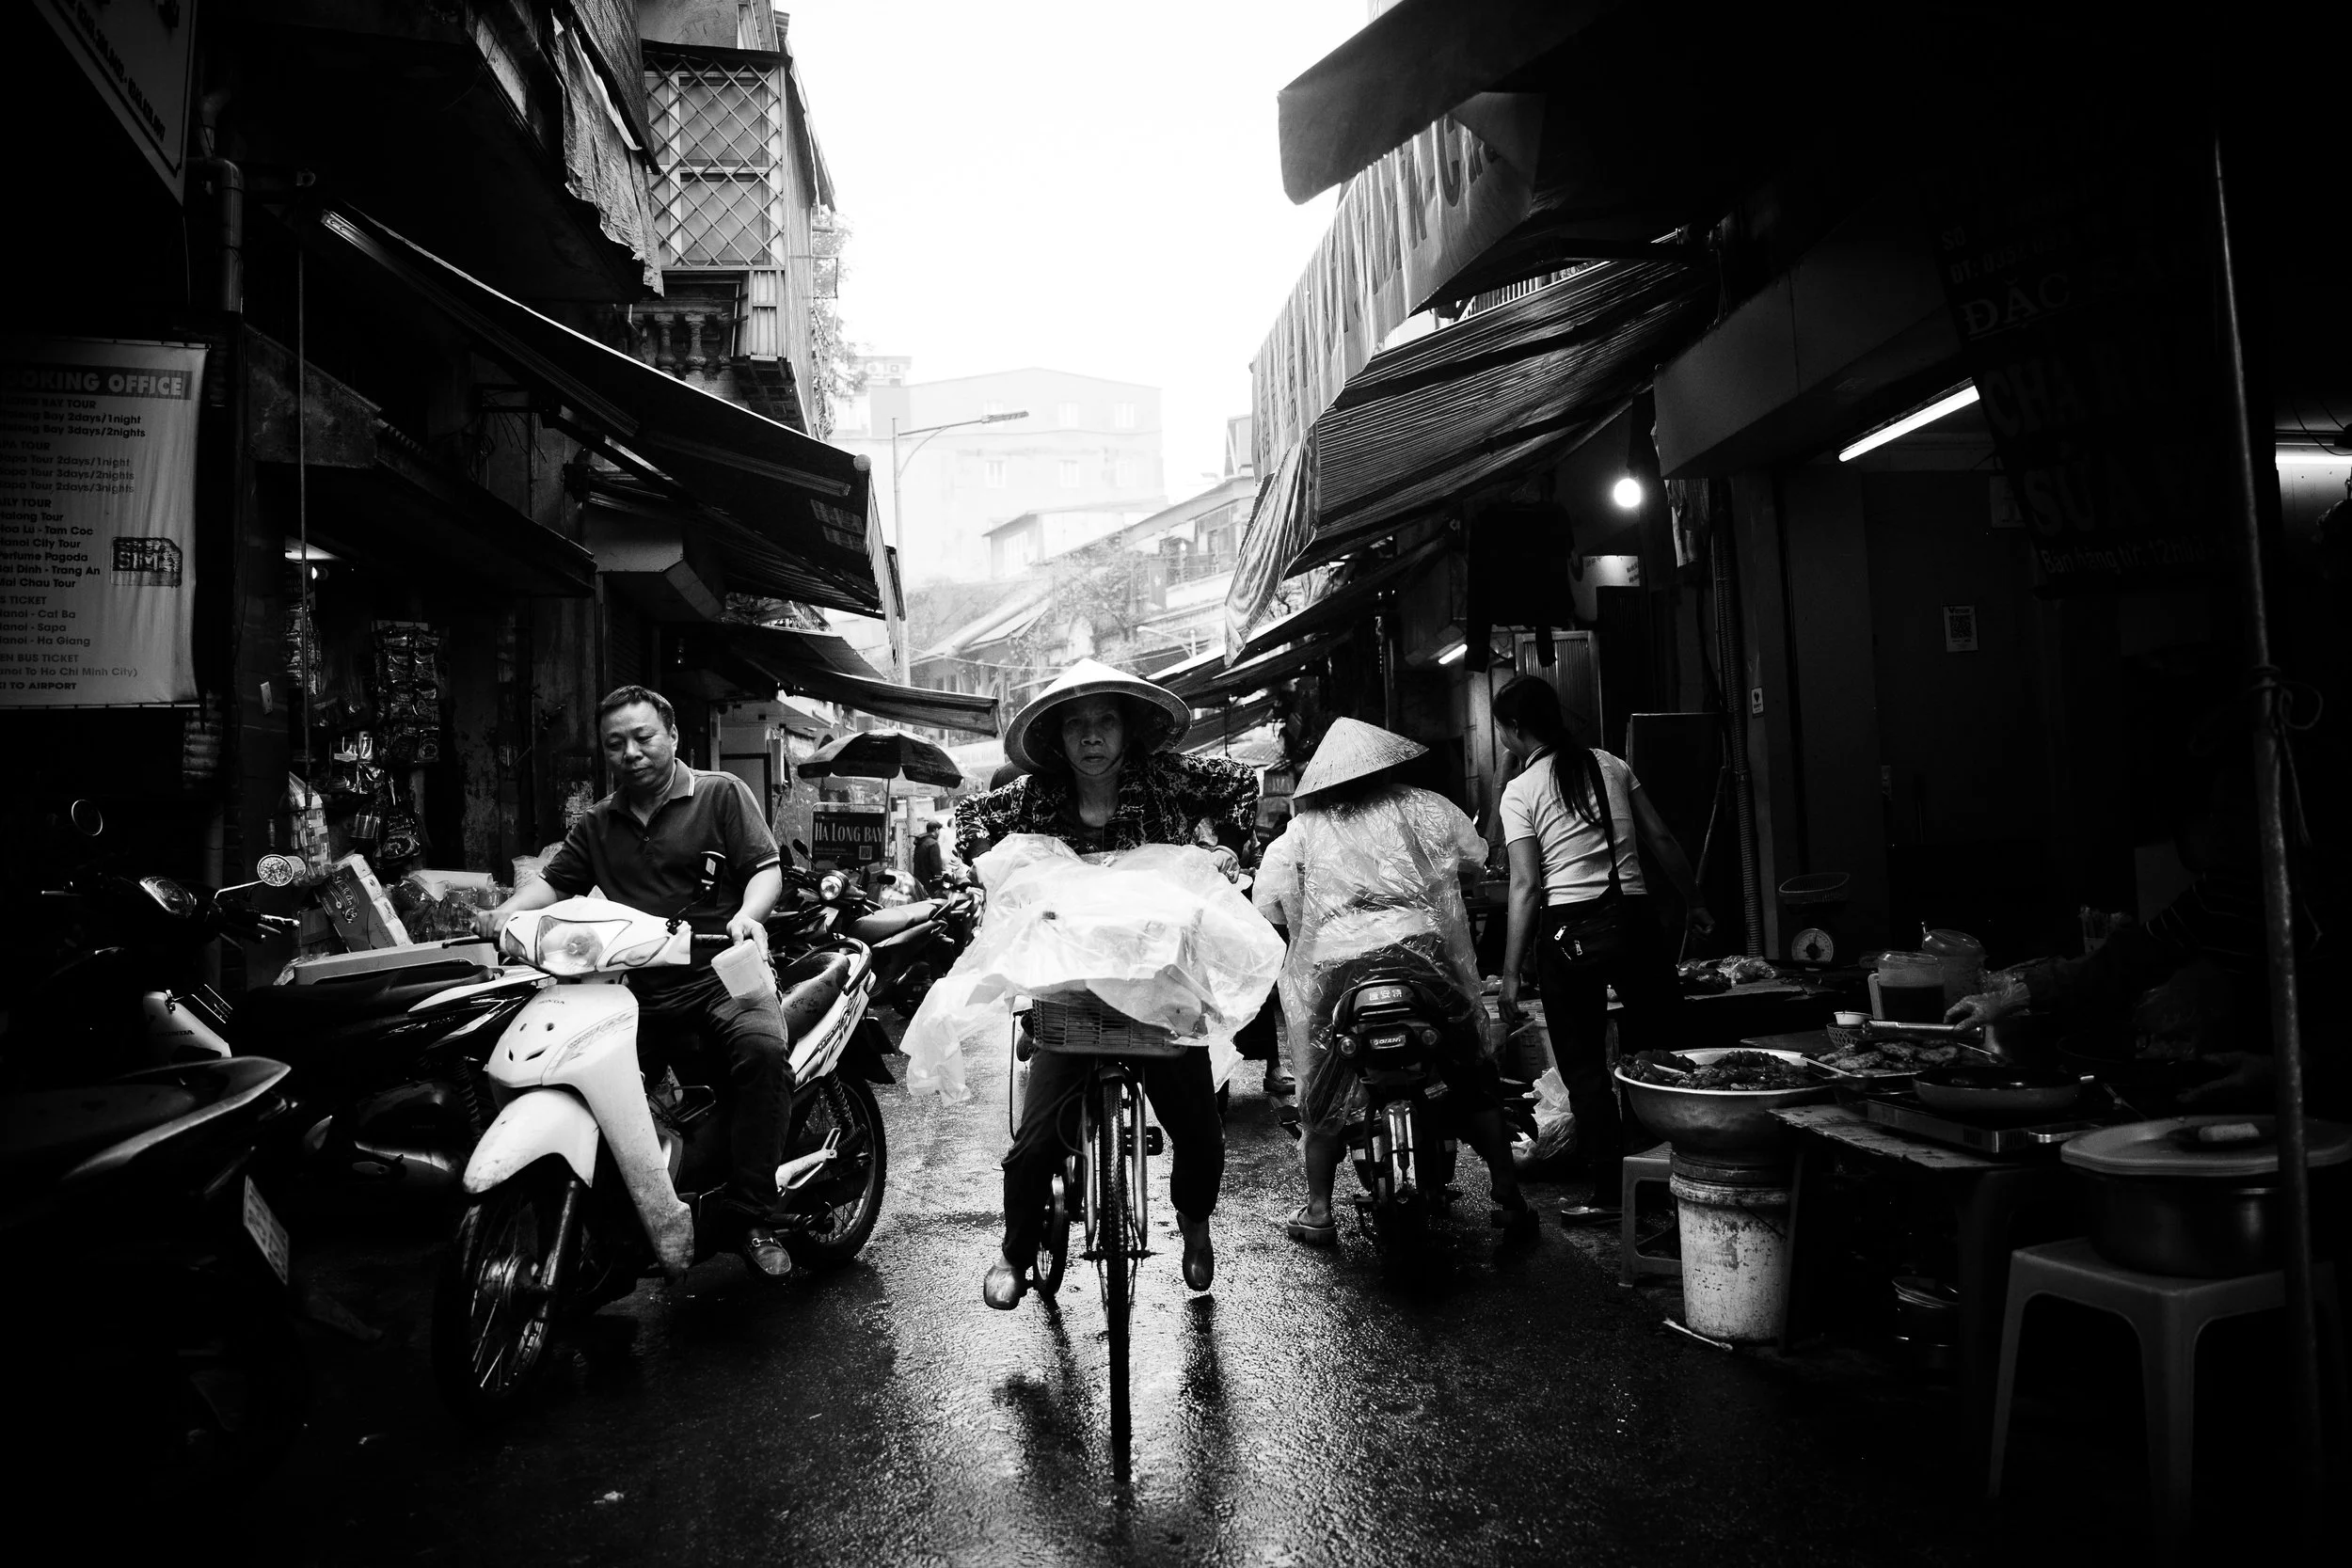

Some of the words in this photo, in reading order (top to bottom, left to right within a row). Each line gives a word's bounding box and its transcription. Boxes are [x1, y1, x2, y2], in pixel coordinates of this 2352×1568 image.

[1959, 271, 2072, 337] ĐẶC
[108, 374, 183, 396] OFFICE
[67, 400, 96, 408] TOUR
[43, 411, 64, 422] Bay
[68, 413, 140, 425] 2days/1night
[43, 424, 64, 435] Bay
[68, 425, 145, 438] 3days/2nights
[0, 439, 17, 449] PA
[22, 441, 50, 450] TOUR
[30, 454, 54, 463] Tour
[57, 455, 129, 467] 2days/1night
[31, 467, 53, 477] Tour
[56, 468, 134, 482] 3days/2nights
[30, 482, 54, 491] Tour
[56, 482, 134, 494] 2days/3nights
[22, 499, 51, 508] TOUR
[41, 512, 63, 521] Tour
[24, 525, 35, 533] Lu
[45, 526, 67, 534] Tam
[71, 527, 93, 535] Coc
[33, 538, 55, 549] City
[58, 539, 80, 547] Tour
[45, 552, 87, 563] Pagoda
[17, 564, 41, 574] Dinh
[52, 565, 82, 577] Trang
[86, 566, 100, 575] An
[20, 578, 50, 587] Chau
[38, 610, 57, 618] Cat
[62, 610, 75, 618] Ba
[38, 624, 66, 633] Sapa
[38, 636, 53, 644] Ha
[56, 637, 90, 647] Giang
[18, 654, 39, 662] BUS
[25, 667, 37, 675] To
[112, 668, 137, 677] City)
[815, 822, 828, 841] HA
[832, 822, 861, 842] LONG
[864, 827, 883, 842] BAY
